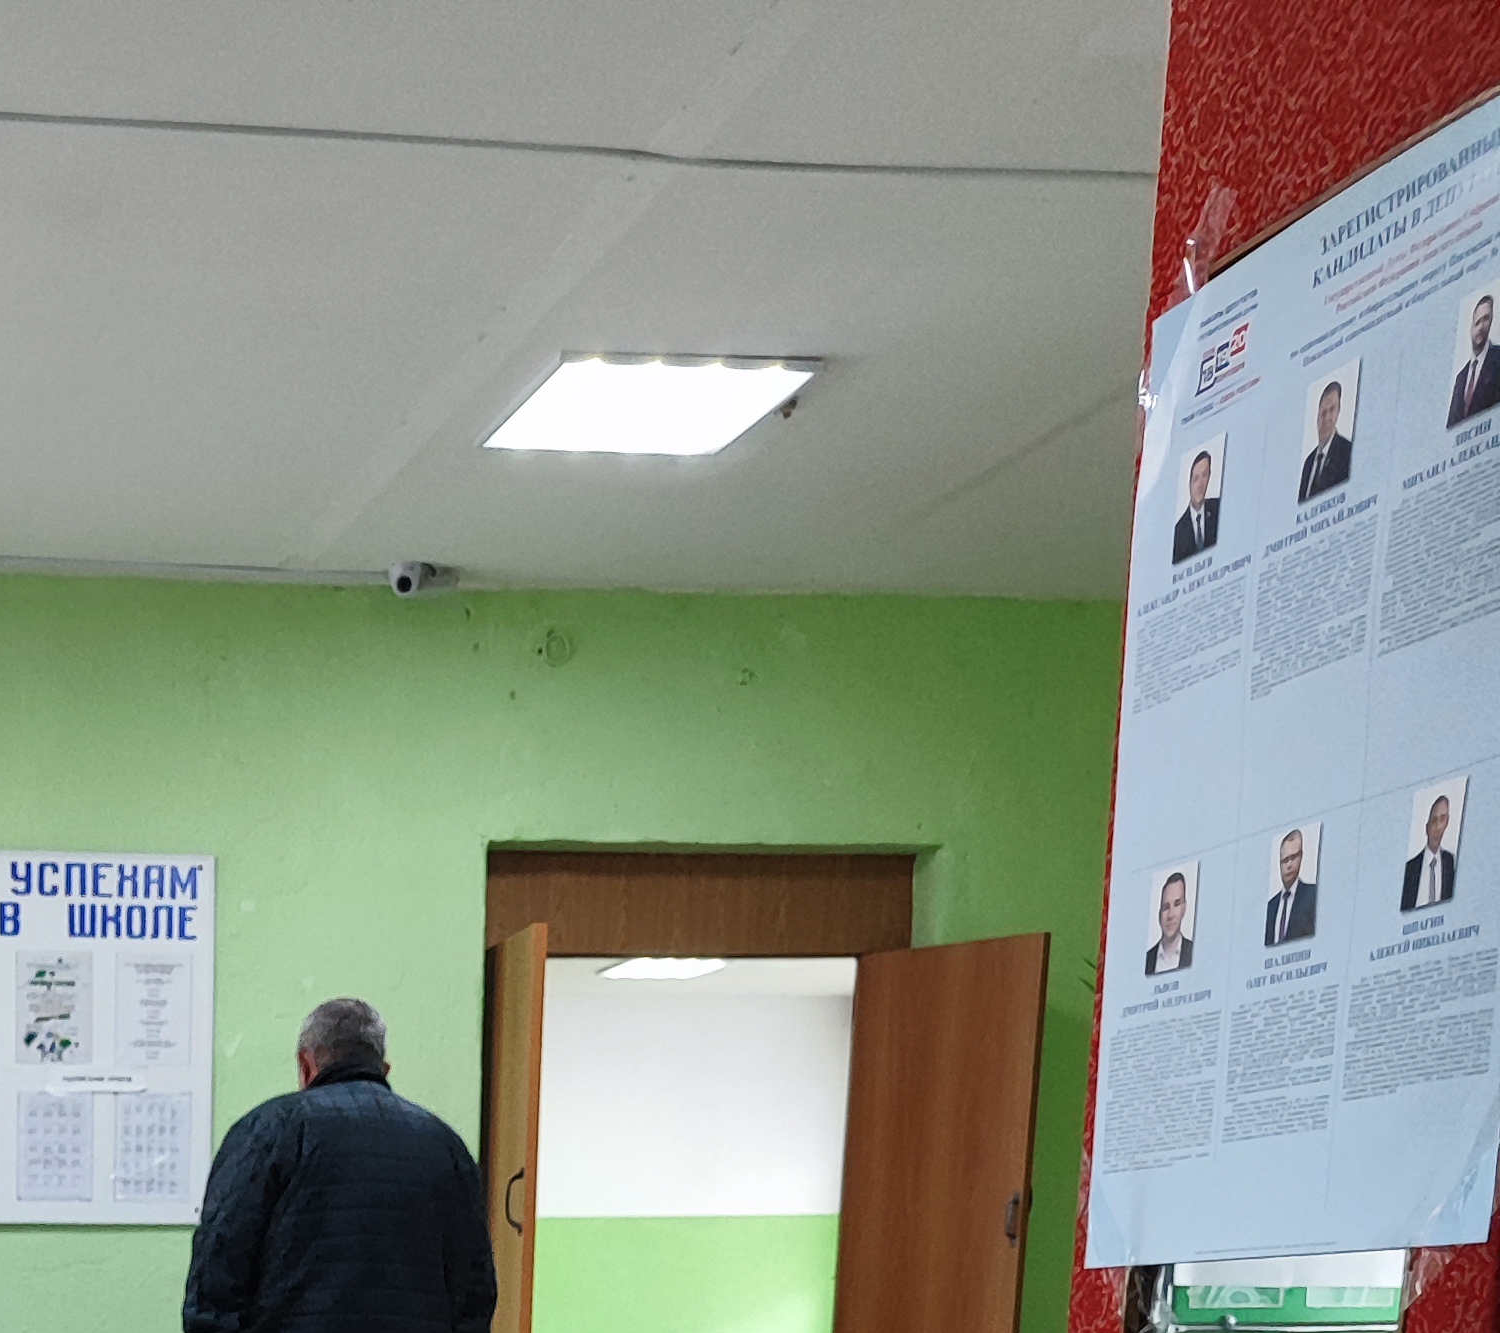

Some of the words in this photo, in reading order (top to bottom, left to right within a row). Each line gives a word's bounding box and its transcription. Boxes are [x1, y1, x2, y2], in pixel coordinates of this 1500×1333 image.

[1320, 127, 1500, 256] ЗАРЕГИСТРИРОВАННЫ
[1312, 216, 1407, 290] КАНДИДАТЫ
[1411, 207, 1421, 230] В
[11, 860, 199, 899] УСПЕХАМ
[0, 902, 21, 937] В
[68, 904, 198, 941] ШКОЛЕ
